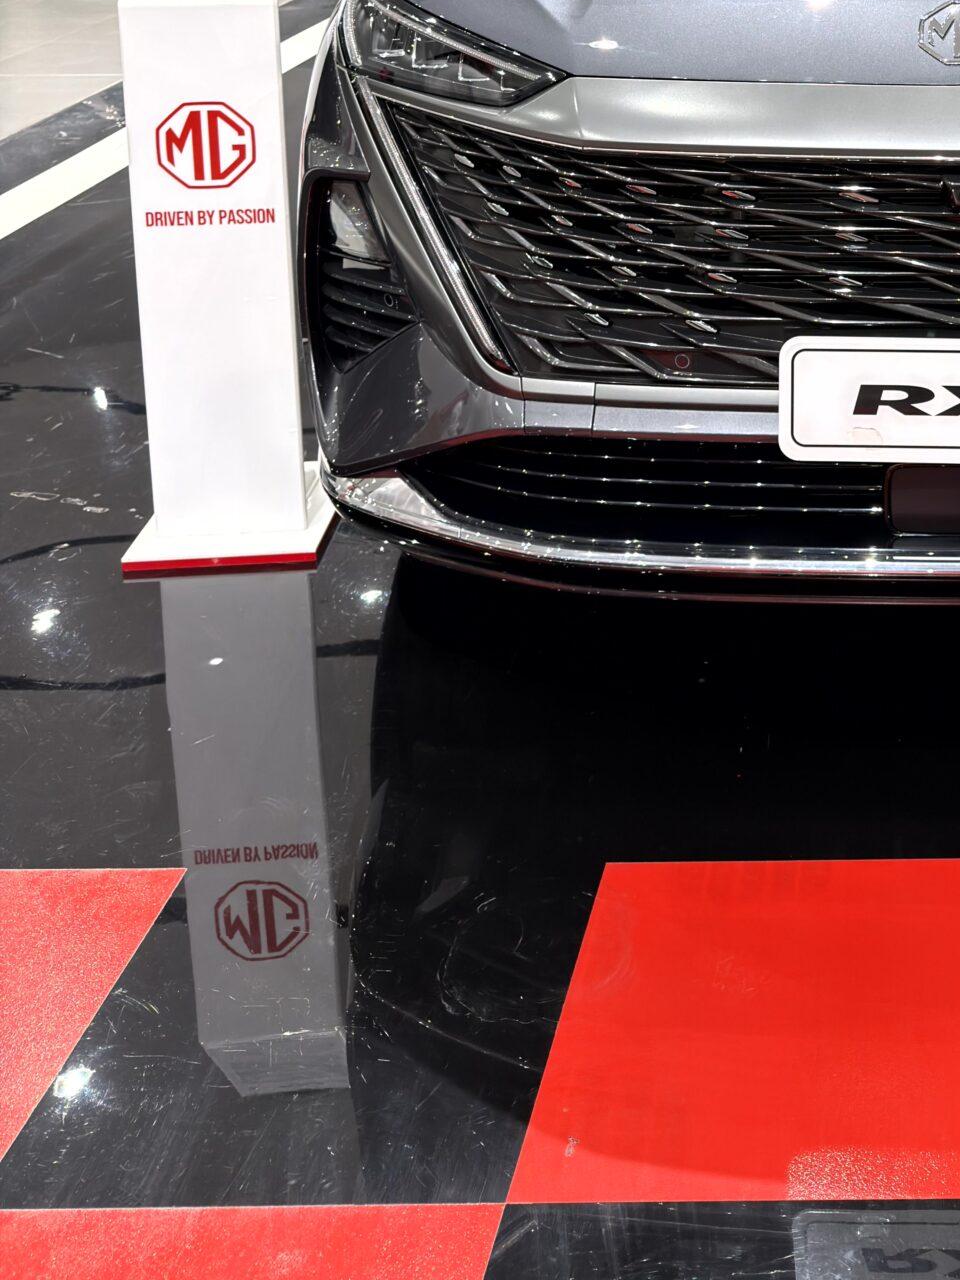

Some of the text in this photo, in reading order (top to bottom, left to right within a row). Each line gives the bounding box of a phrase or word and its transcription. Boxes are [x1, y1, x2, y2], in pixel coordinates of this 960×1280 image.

[165, 110, 247, 181] MG
[145, 208, 276, 227] DRIVEN BY PASSION
